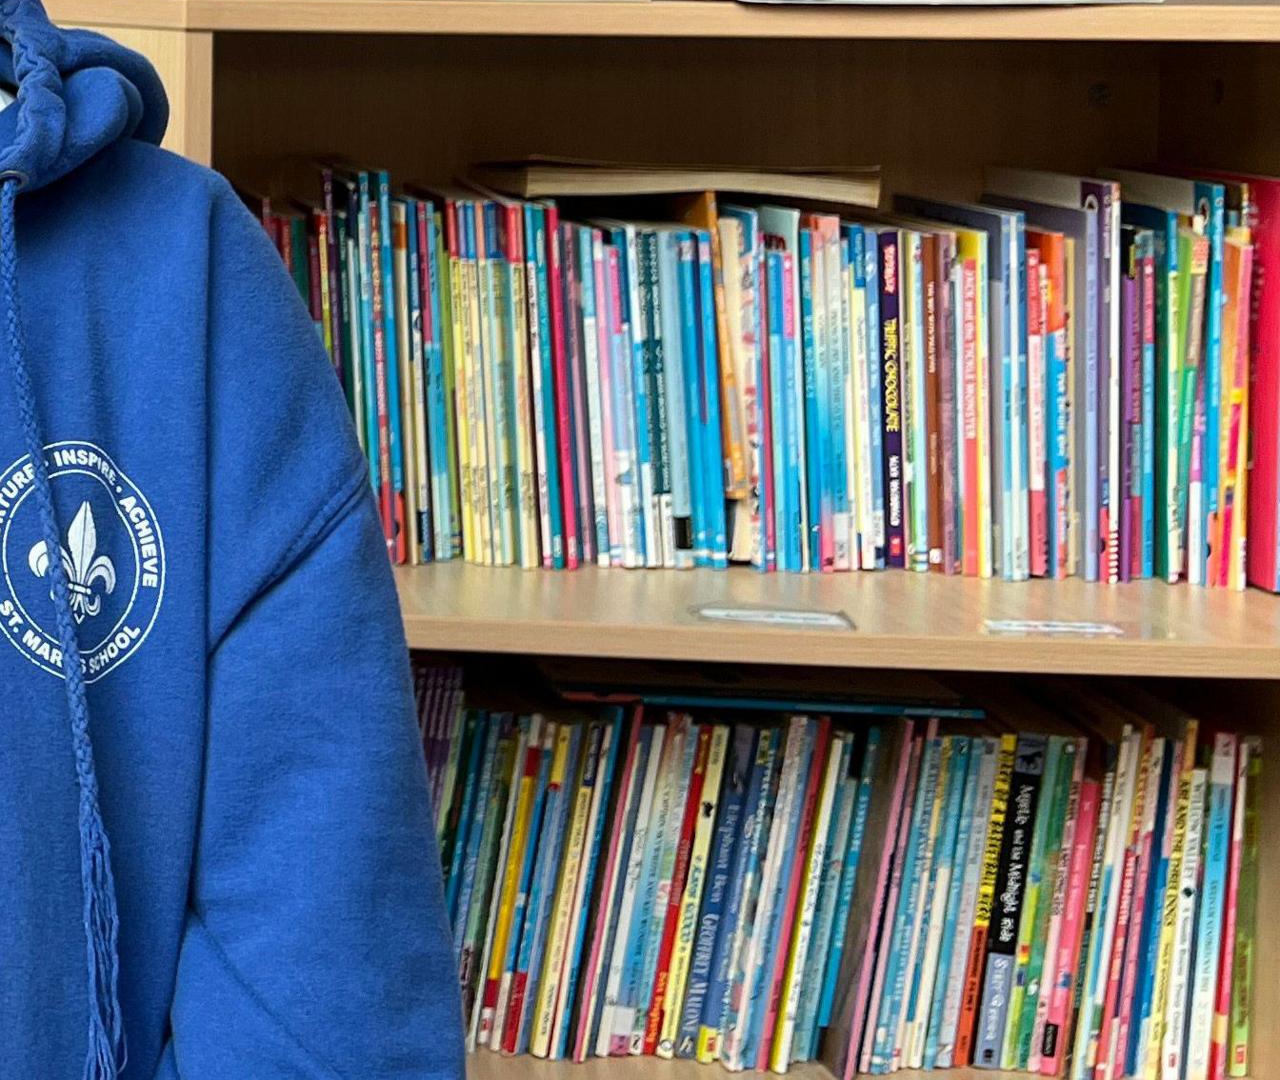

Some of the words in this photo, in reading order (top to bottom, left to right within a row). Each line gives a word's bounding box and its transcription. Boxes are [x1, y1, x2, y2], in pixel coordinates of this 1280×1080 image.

[963, 269, 974, 297] JACK
[964, 301, 973, 319] and
[964, 322, 974, 339] the
[964, 383, 975, 439] MONSTER
[53, 449, 117, 486] INSPIRE
[119, 495, 159, 588] ACHIEVE
[89, 624, 142, 674] SCHOOL
[998, 861, 1023, 914] Midnight
[998, 916, 1016, 943] Ride
